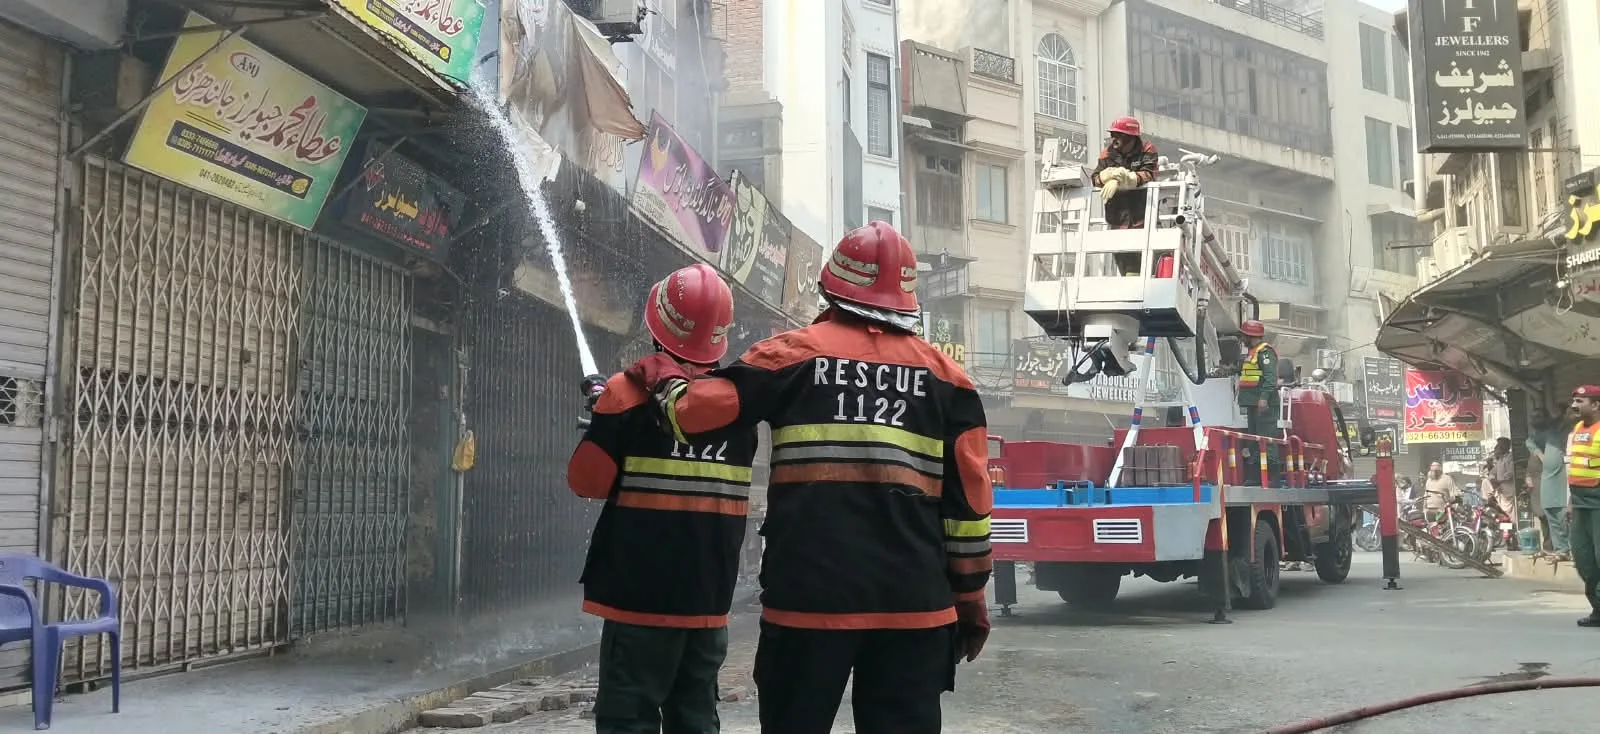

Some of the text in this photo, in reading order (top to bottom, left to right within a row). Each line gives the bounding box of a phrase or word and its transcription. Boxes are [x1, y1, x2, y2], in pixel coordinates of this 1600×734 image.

[1434, 36, 1510, 46] JEWELLERS
[239, 57, 260, 78] AMJ
[1435, 59, 1514, 94] شریف
[227, 88, 283, 140] جیولرز
[256, 96, 315, 147] محمد
[1437, 96, 1517, 125] جیولرز
[814, 356, 929, 397] RESCUE
[1091, 385, 1138, 401] JEWELLERS
[833, 391, 907, 427] 1122
[670, 440, 728, 461] 1122
[1407, 432, 1468, 441] 321-6639164
